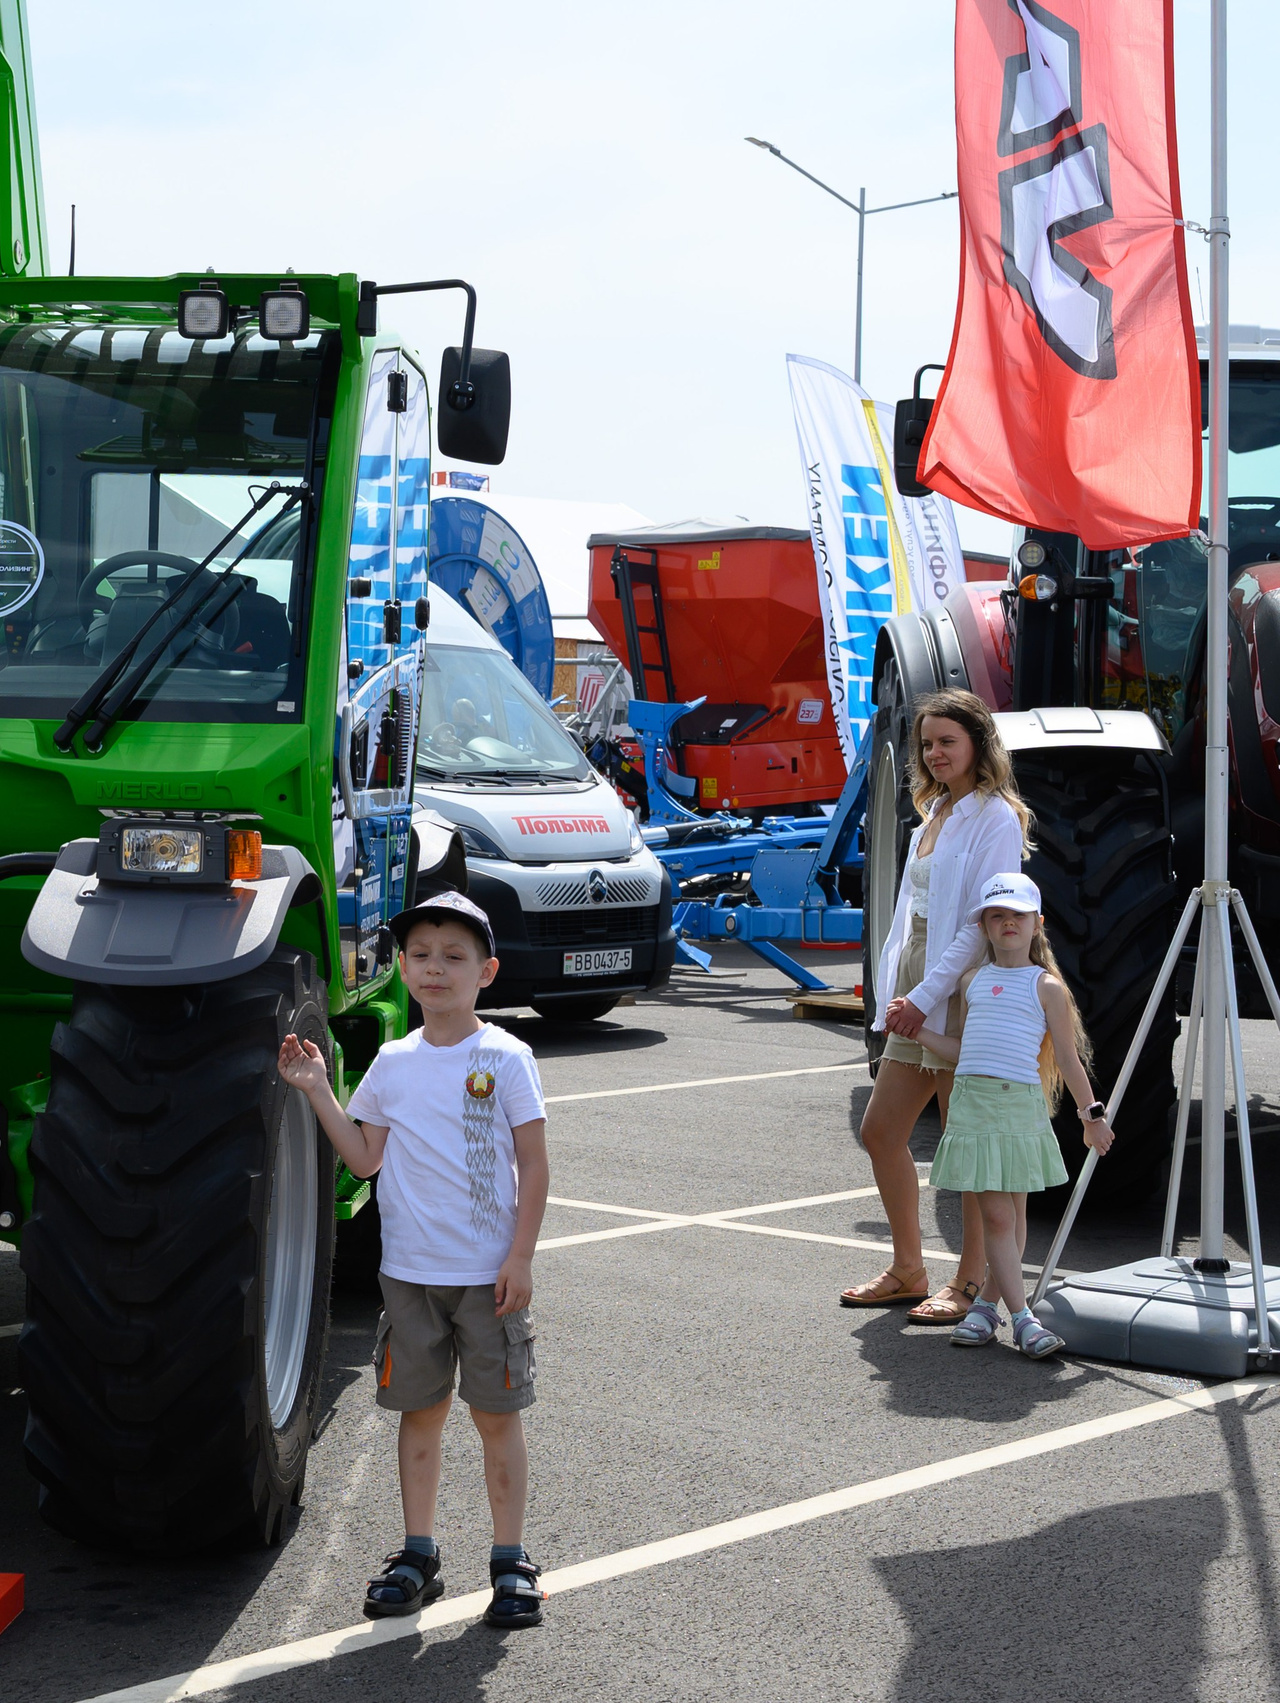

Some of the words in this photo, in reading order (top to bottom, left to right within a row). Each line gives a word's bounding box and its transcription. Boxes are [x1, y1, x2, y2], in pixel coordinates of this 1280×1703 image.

[799, 709, 815, 719] 237
[95, 779, 205, 802] MERLO
[511, 814, 611, 836] Полымя
